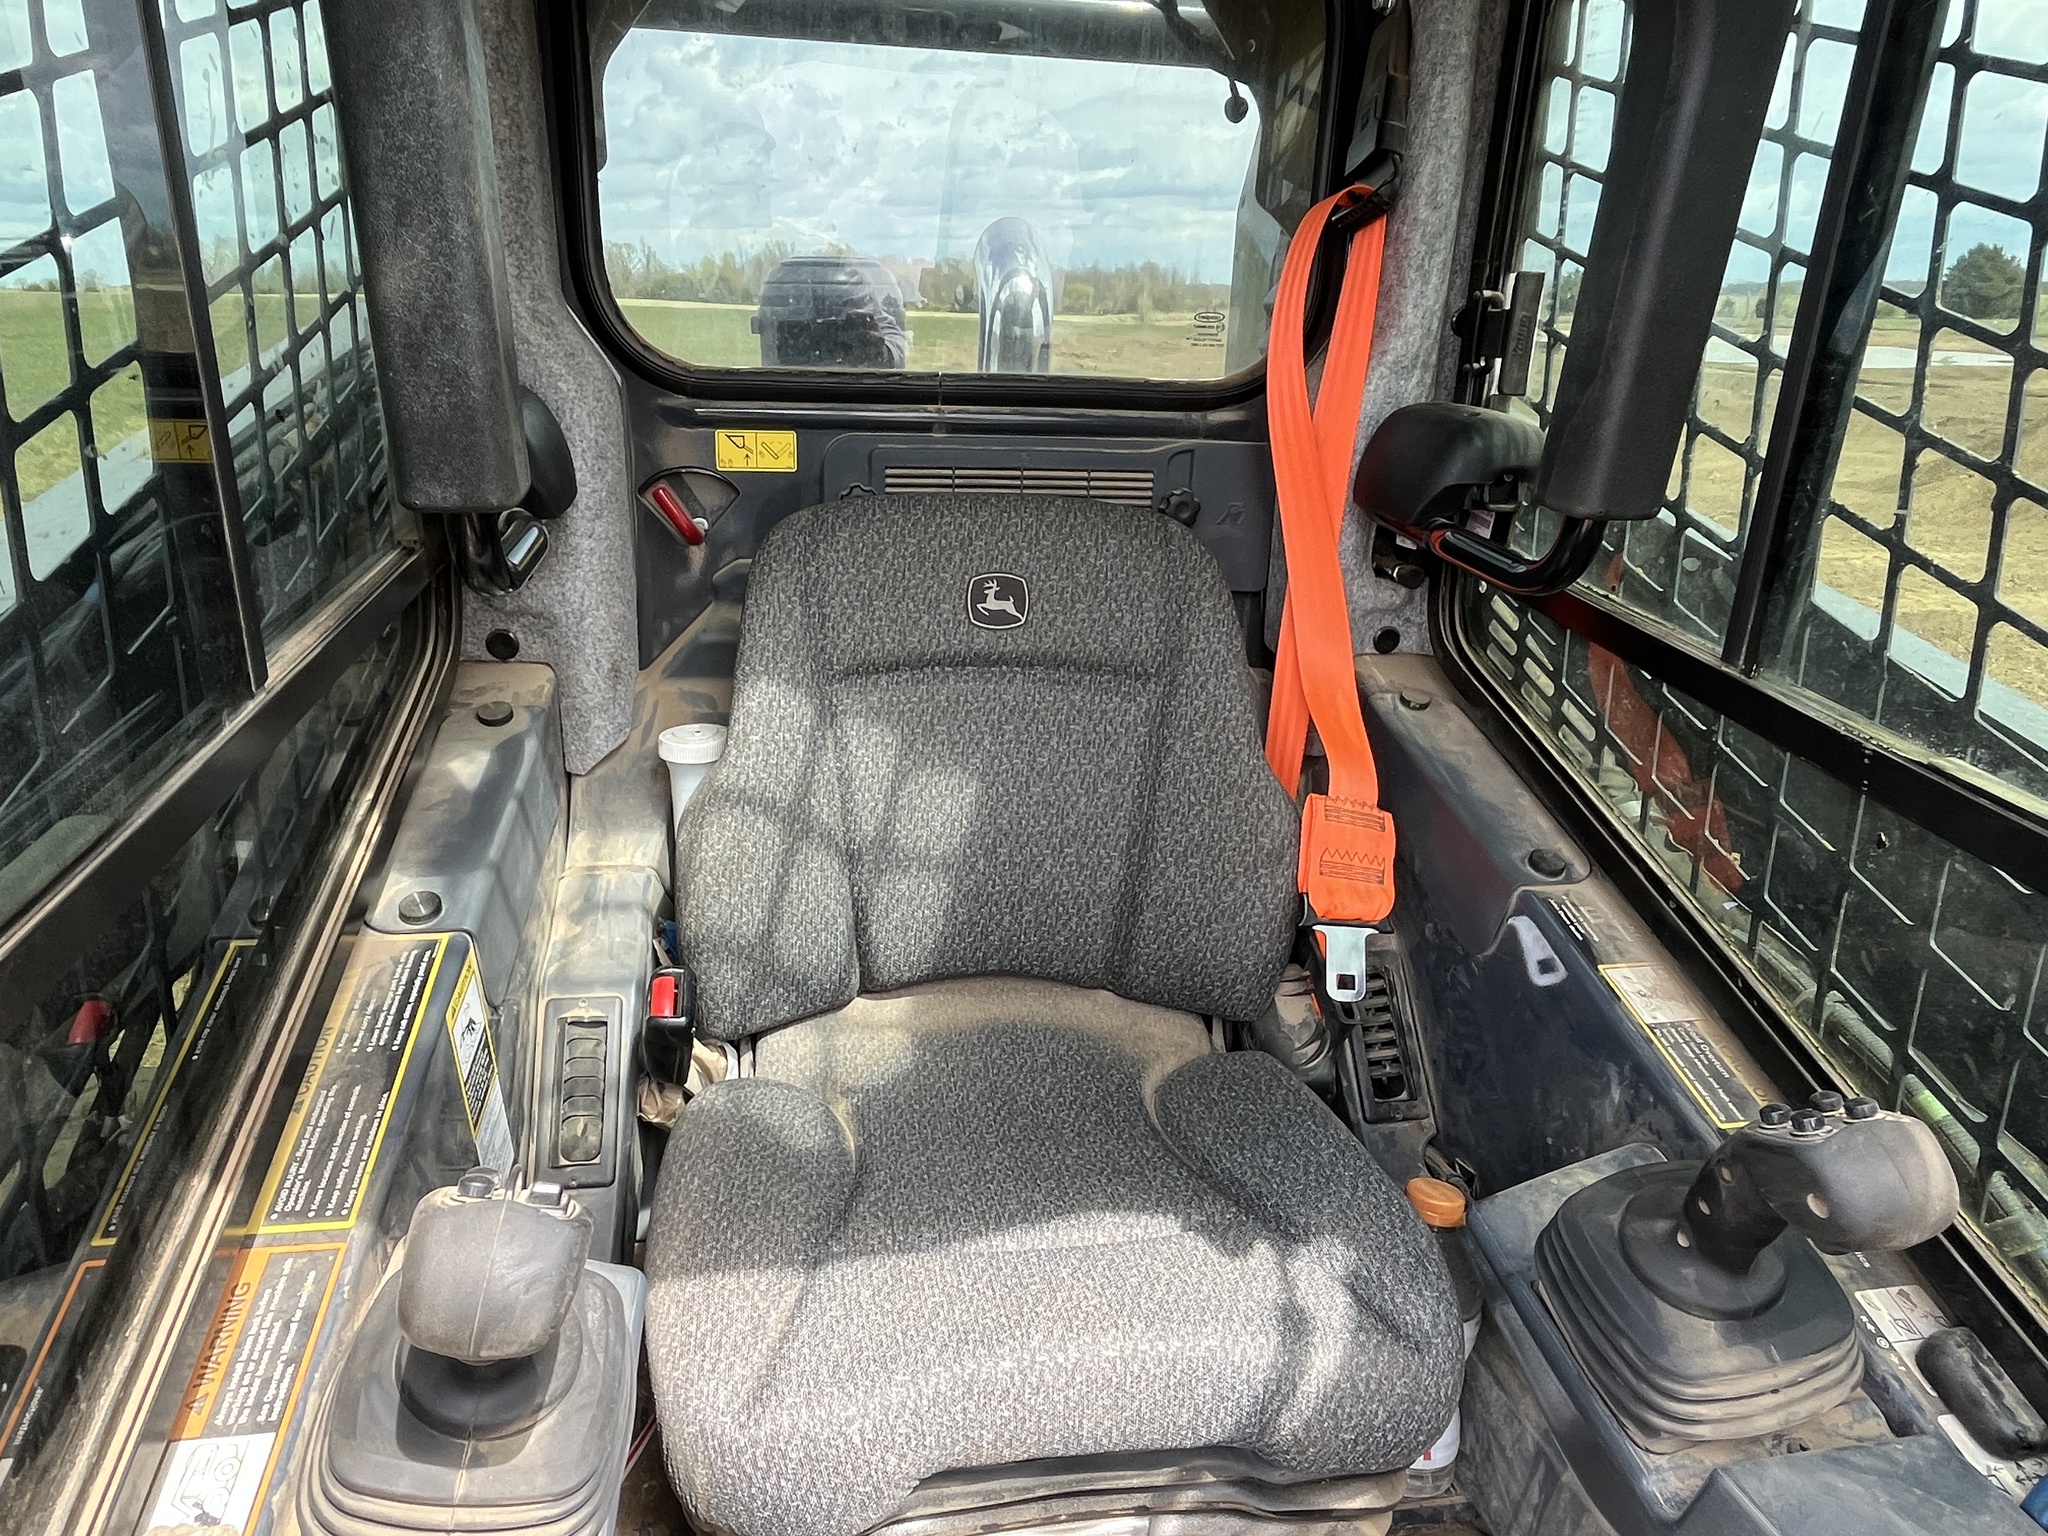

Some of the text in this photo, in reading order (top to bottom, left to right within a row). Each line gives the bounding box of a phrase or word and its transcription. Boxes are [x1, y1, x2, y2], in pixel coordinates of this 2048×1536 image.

[1700, 1044, 1729, 1077] Overturn
[274, 1189, 289, 1212] AVOID
[283, 1162, 299, 1188] INJURY
[295, 1139, 308, 1157] Read
[304, 1126, 313, 1139] and
[284, 1175, 304, 1211] Operator's
[298, 1149, 313, 1174] Manual
[308, 1127, 321, 1148] before
[318, 1097, 334, 1126] operating
[310, 1189, 323, 1210] Know
[318, 1161, 334, 1188] location
[329, 1147, 339, 1160] and
[344, 1111, 351, 1119] of
[344, 1189, 357, 1208] Keep
[361, 1147, 370, 1160] and
[366, 1118, 380, 1146] windows
[327, 1190, 340, 1209] Keep
[192, 1282, 251, 1389] WARNING
[214, 1392, 234, 1425] Always
[255, 1288, 272, 1315] before
[246, 1361, 256, 1372] or
[256, 1403, 270, 1422] See
[263, 1355, 288, 1402] Operator's
[280, 1322, 298, 1353] Manual
[227, 1387, 248, 1425] working
[236, 1408, 251, 1425] the
[242, 1373, 252, 1385] on
